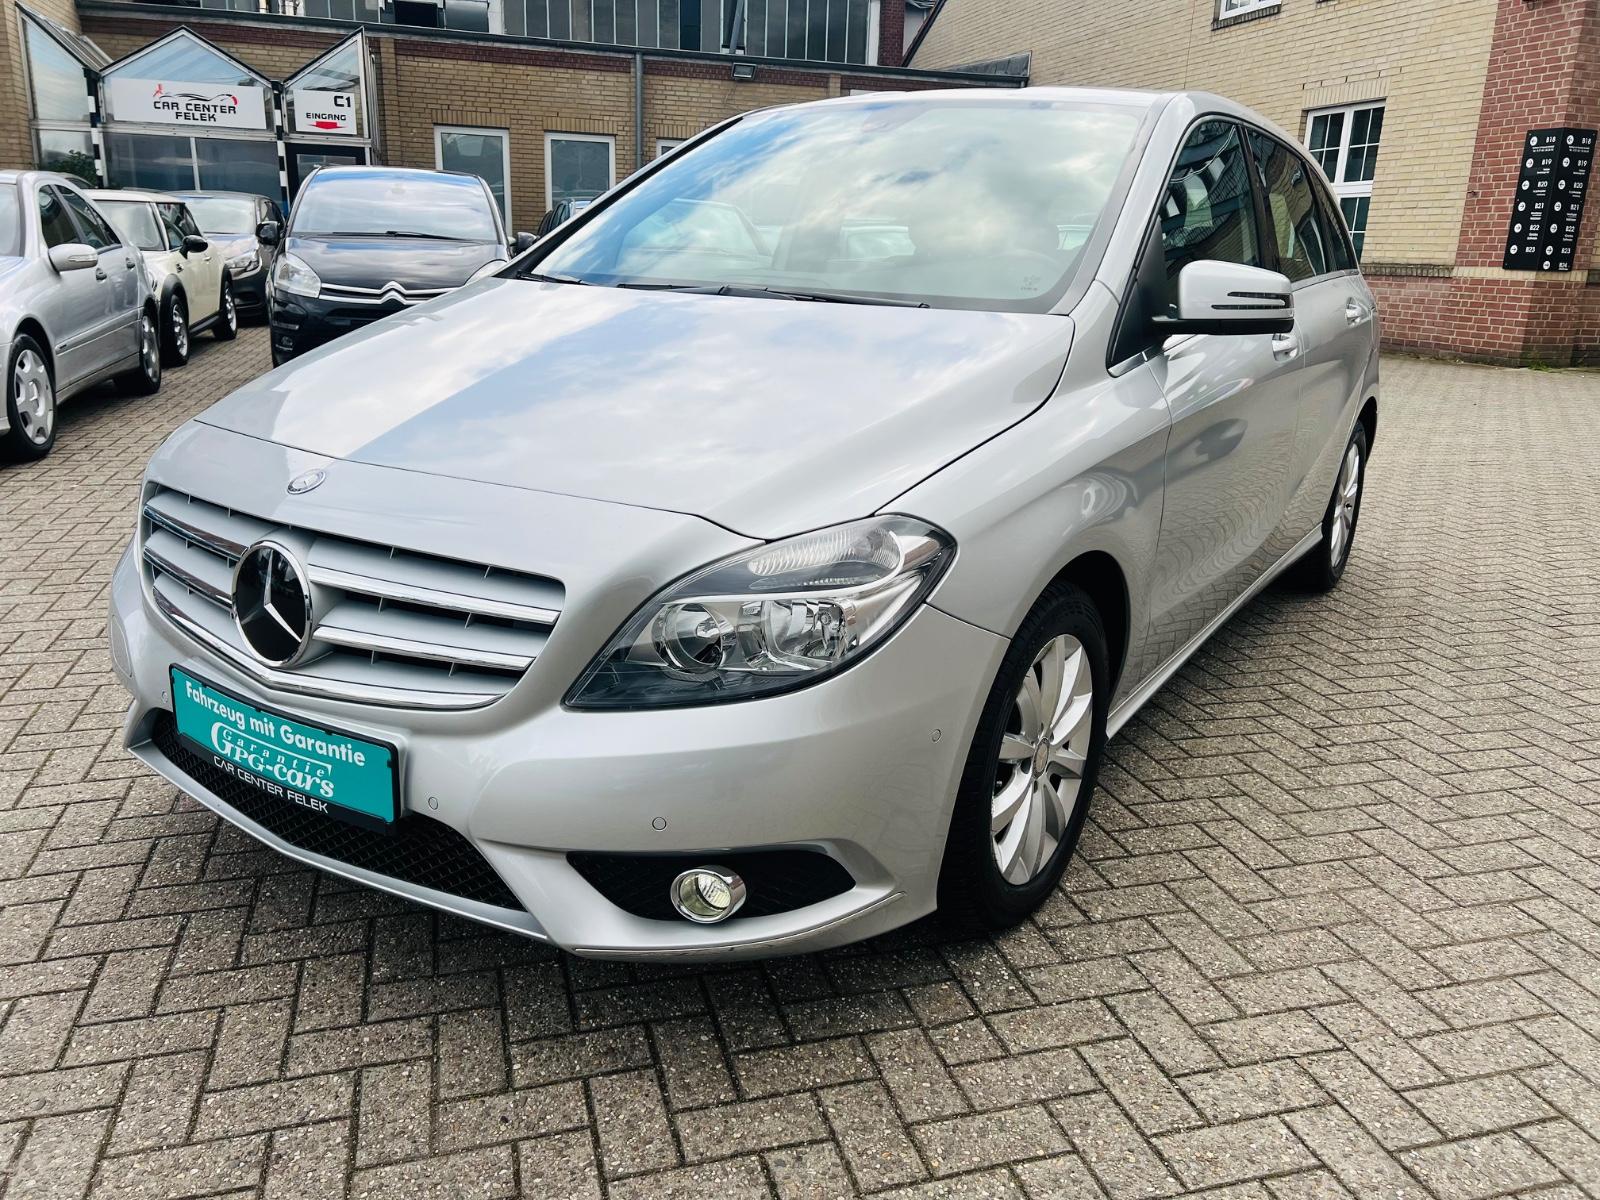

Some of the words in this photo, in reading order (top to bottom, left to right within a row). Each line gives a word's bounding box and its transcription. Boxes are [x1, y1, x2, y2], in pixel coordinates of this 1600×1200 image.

[154, 101, 179, 110] CAR
[186, 103, 236, 114] CENTER
[176, 112, 217, 122] FELEK
[334, 96, 351, 108] C1
[186, 681, 244, 728] Fahrzeug
[250, 714, 274, 738] mit
[280, 725, 365, 766] Garantie
[223, 729, 325, 777] Garantie
[214, 756, 234, 773] CAR
[238, 769, 283, 797] CENTER
[287, 790, 328, 813] FELEK
